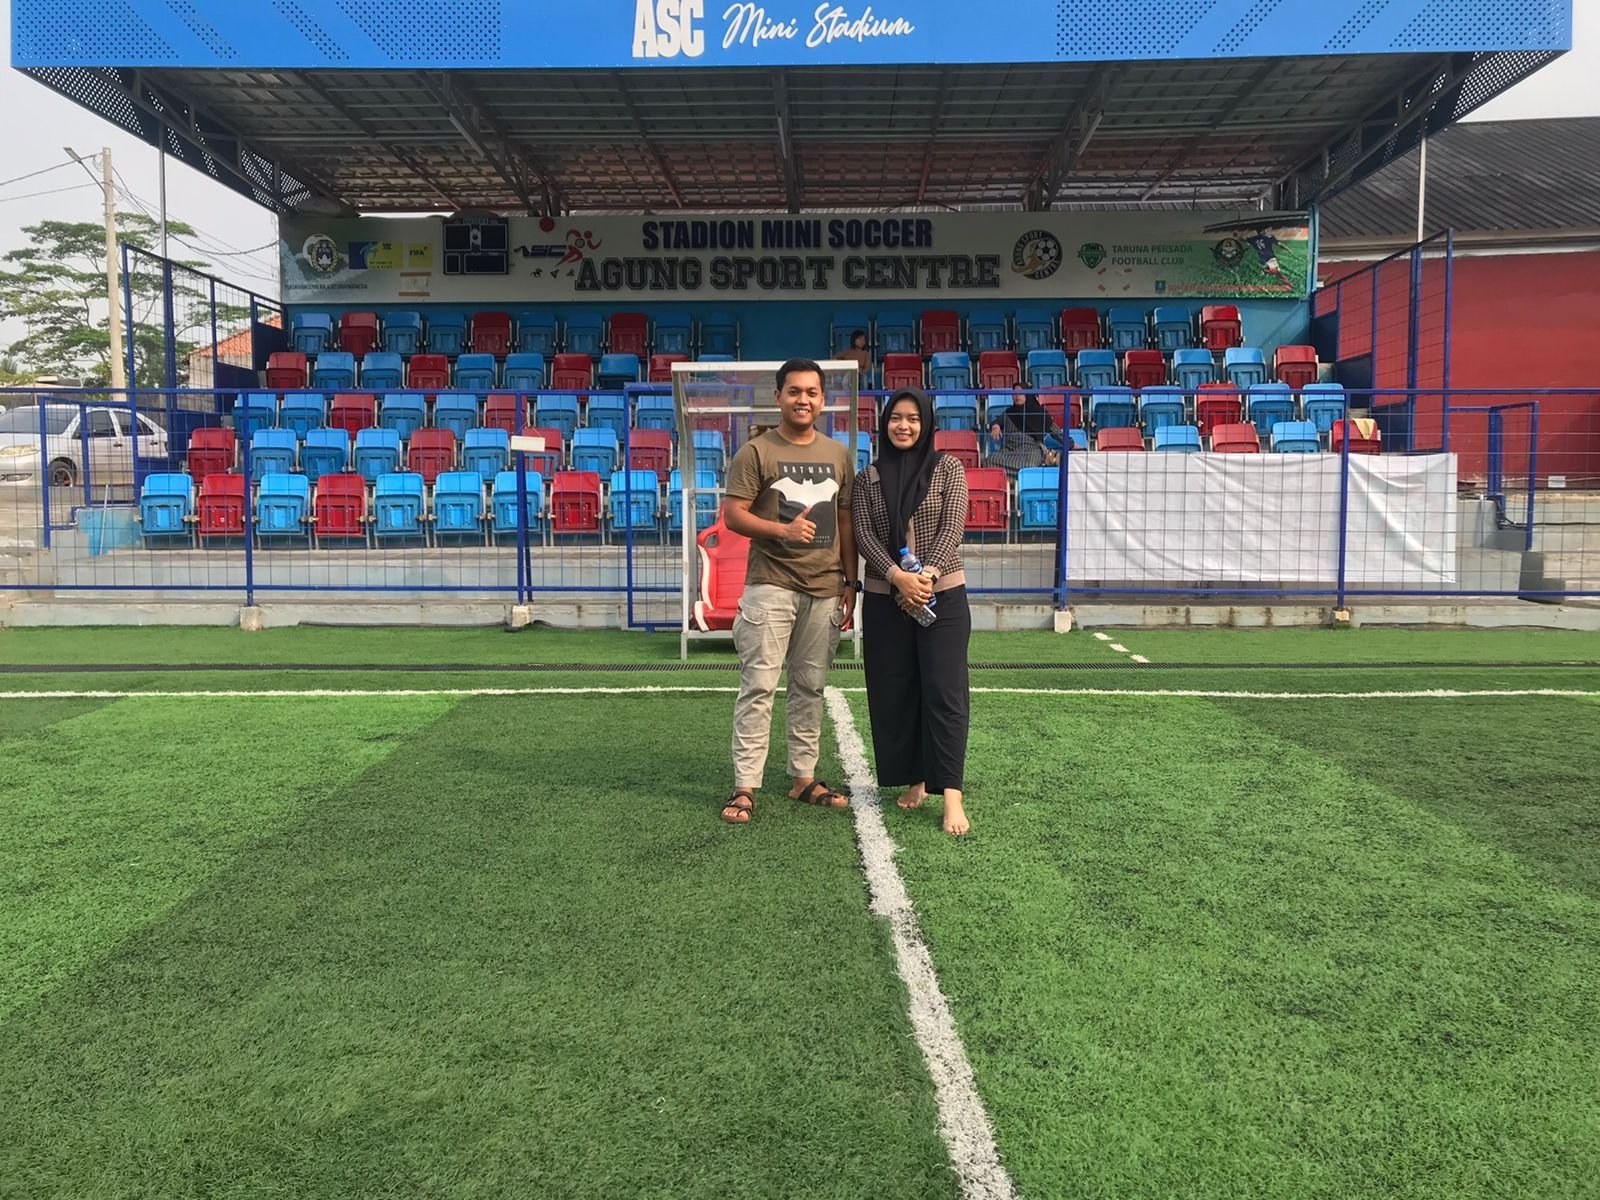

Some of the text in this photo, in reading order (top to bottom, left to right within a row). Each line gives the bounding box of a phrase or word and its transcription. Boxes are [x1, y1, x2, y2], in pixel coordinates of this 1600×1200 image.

[632, 0, 916, 58] ASC Mini Stadium
[643, 218, 933, 250] STADION MINI SOCCER
[1111, 244, 1194, 254] TARUNA PERSADA
[1112, 256, 1185, 266] FOOTBALL CLUB
[574, 254, 1001, 291] AGUNG SPORT CENTRE
[783, 465, 832, 474] BATMAN
